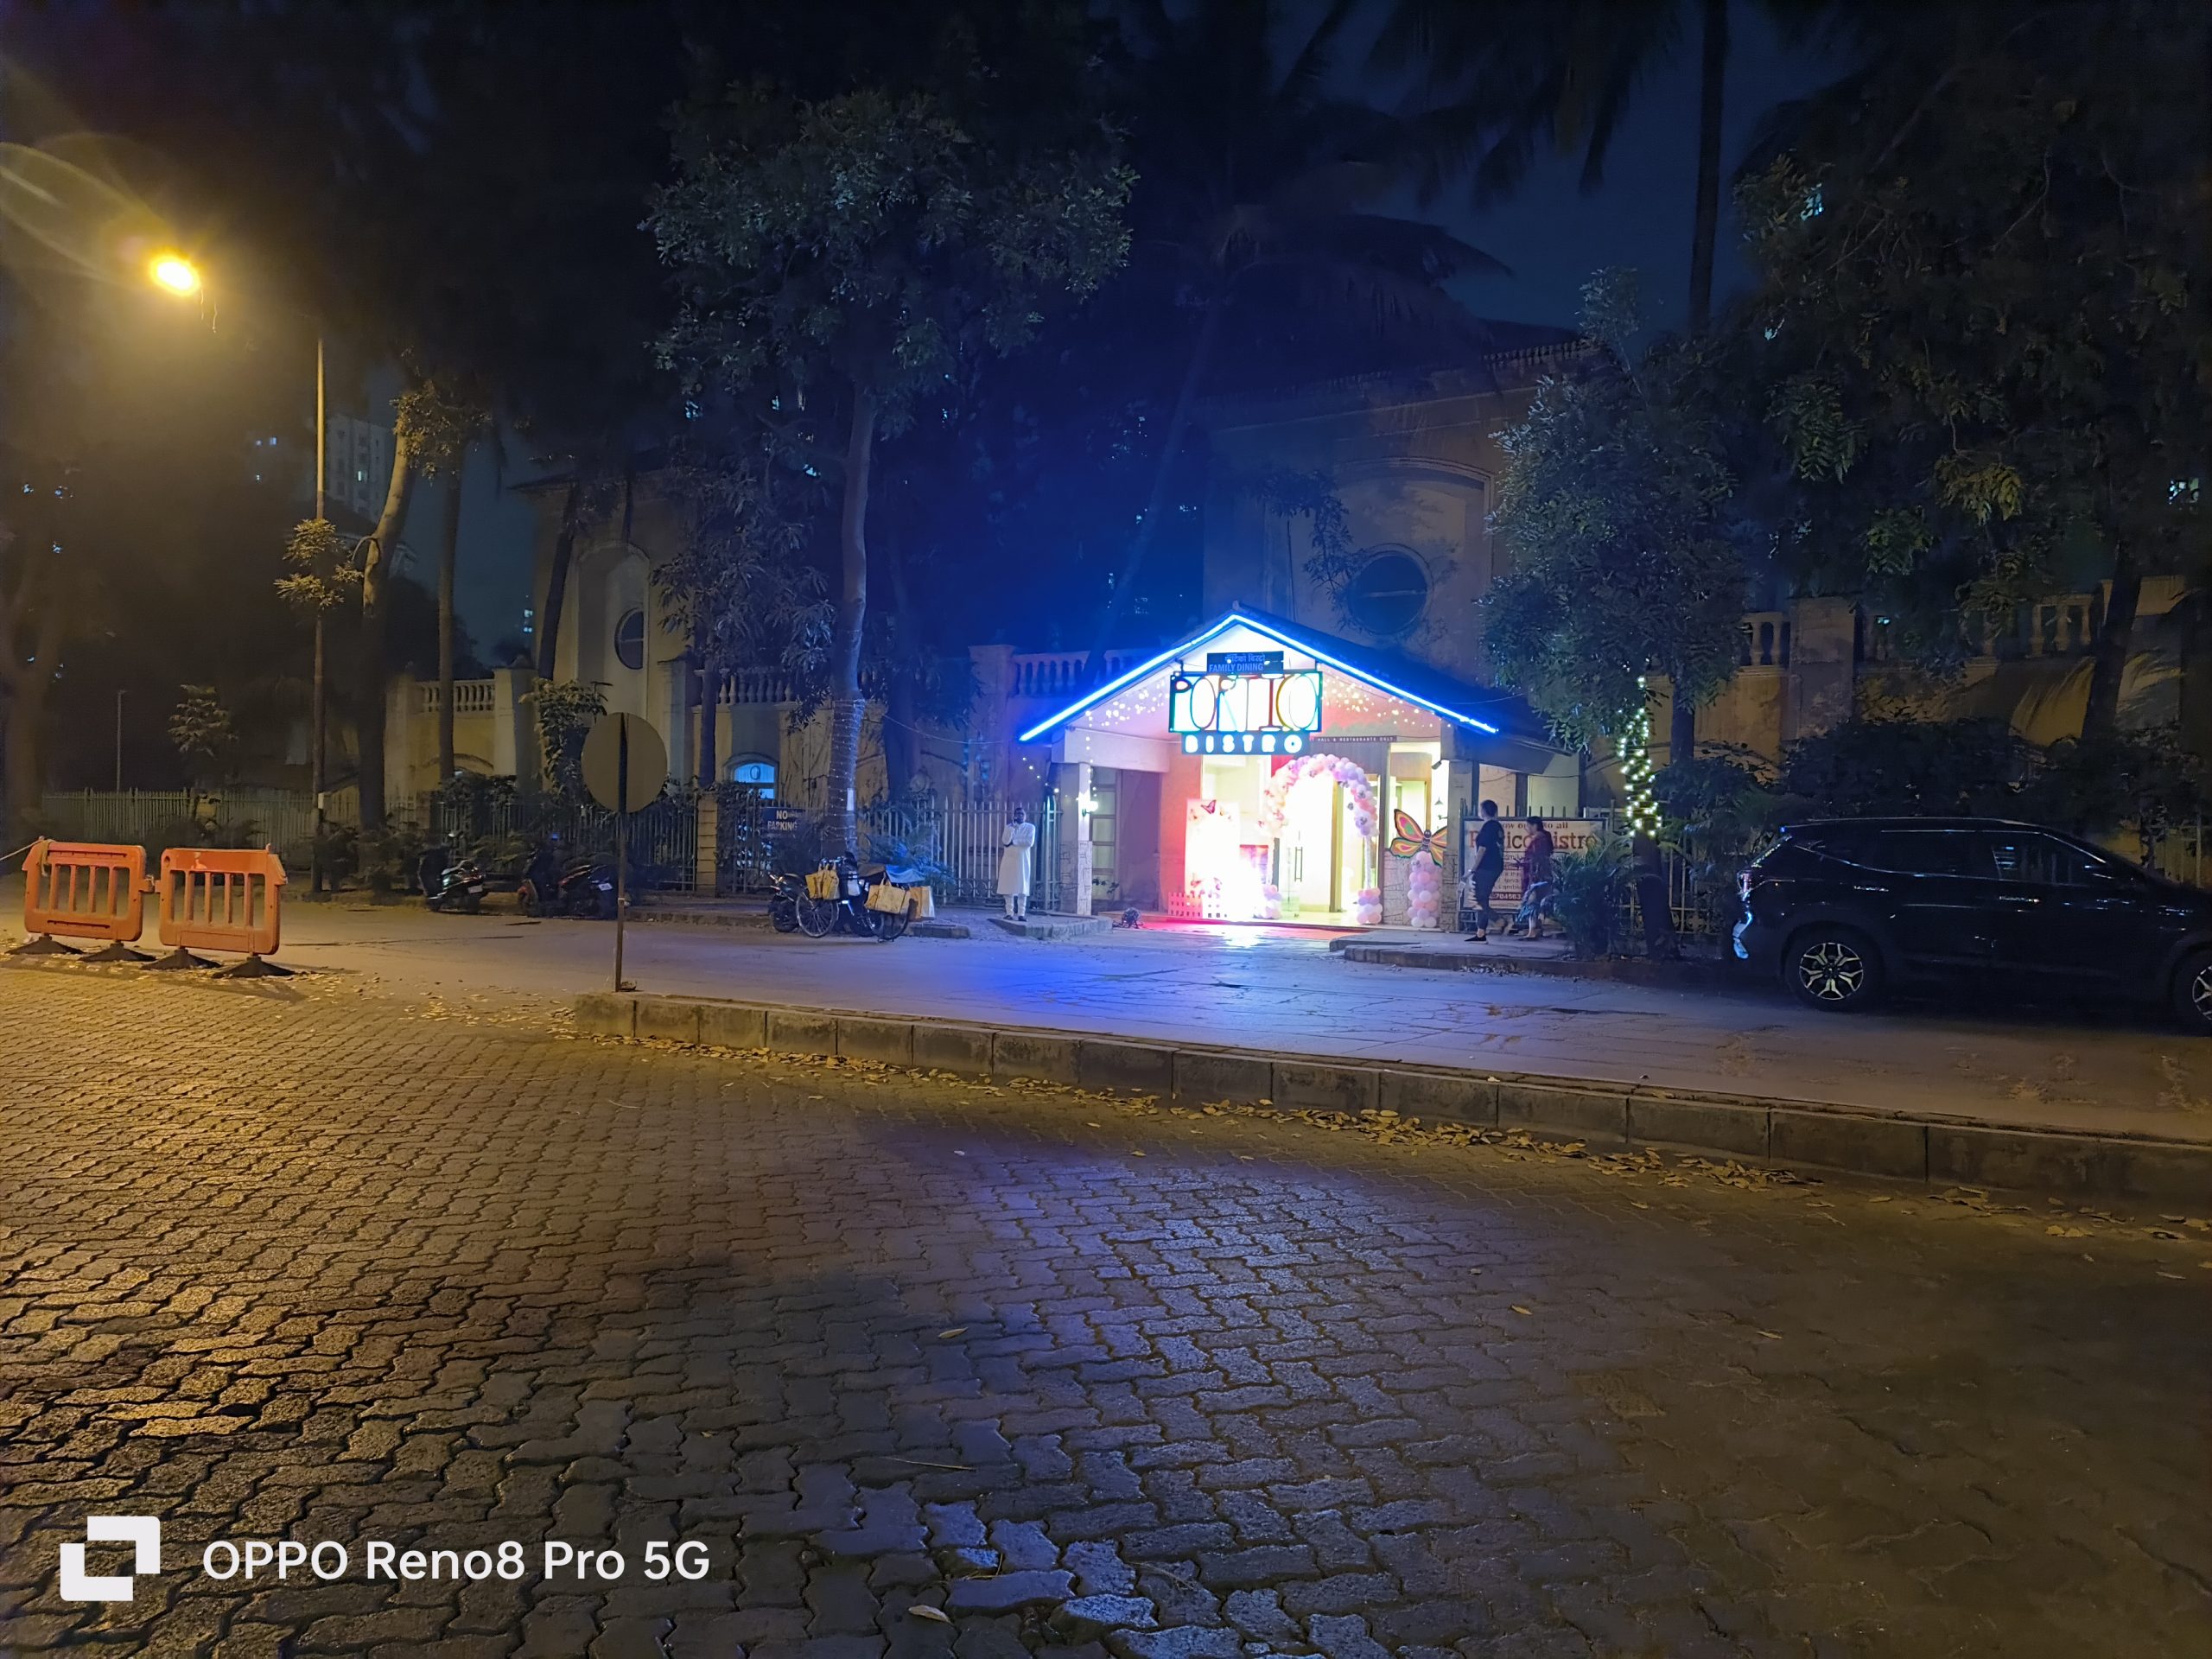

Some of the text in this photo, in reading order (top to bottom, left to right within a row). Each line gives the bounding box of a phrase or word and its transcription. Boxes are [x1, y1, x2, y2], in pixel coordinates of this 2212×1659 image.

[1209, 663, 1263, 672] FAMILY DINING
[1185, 734, 1303, 753] BISTRO
[776, 810, 788, 820] NO
[767, 820, 798, 831] PARKING
